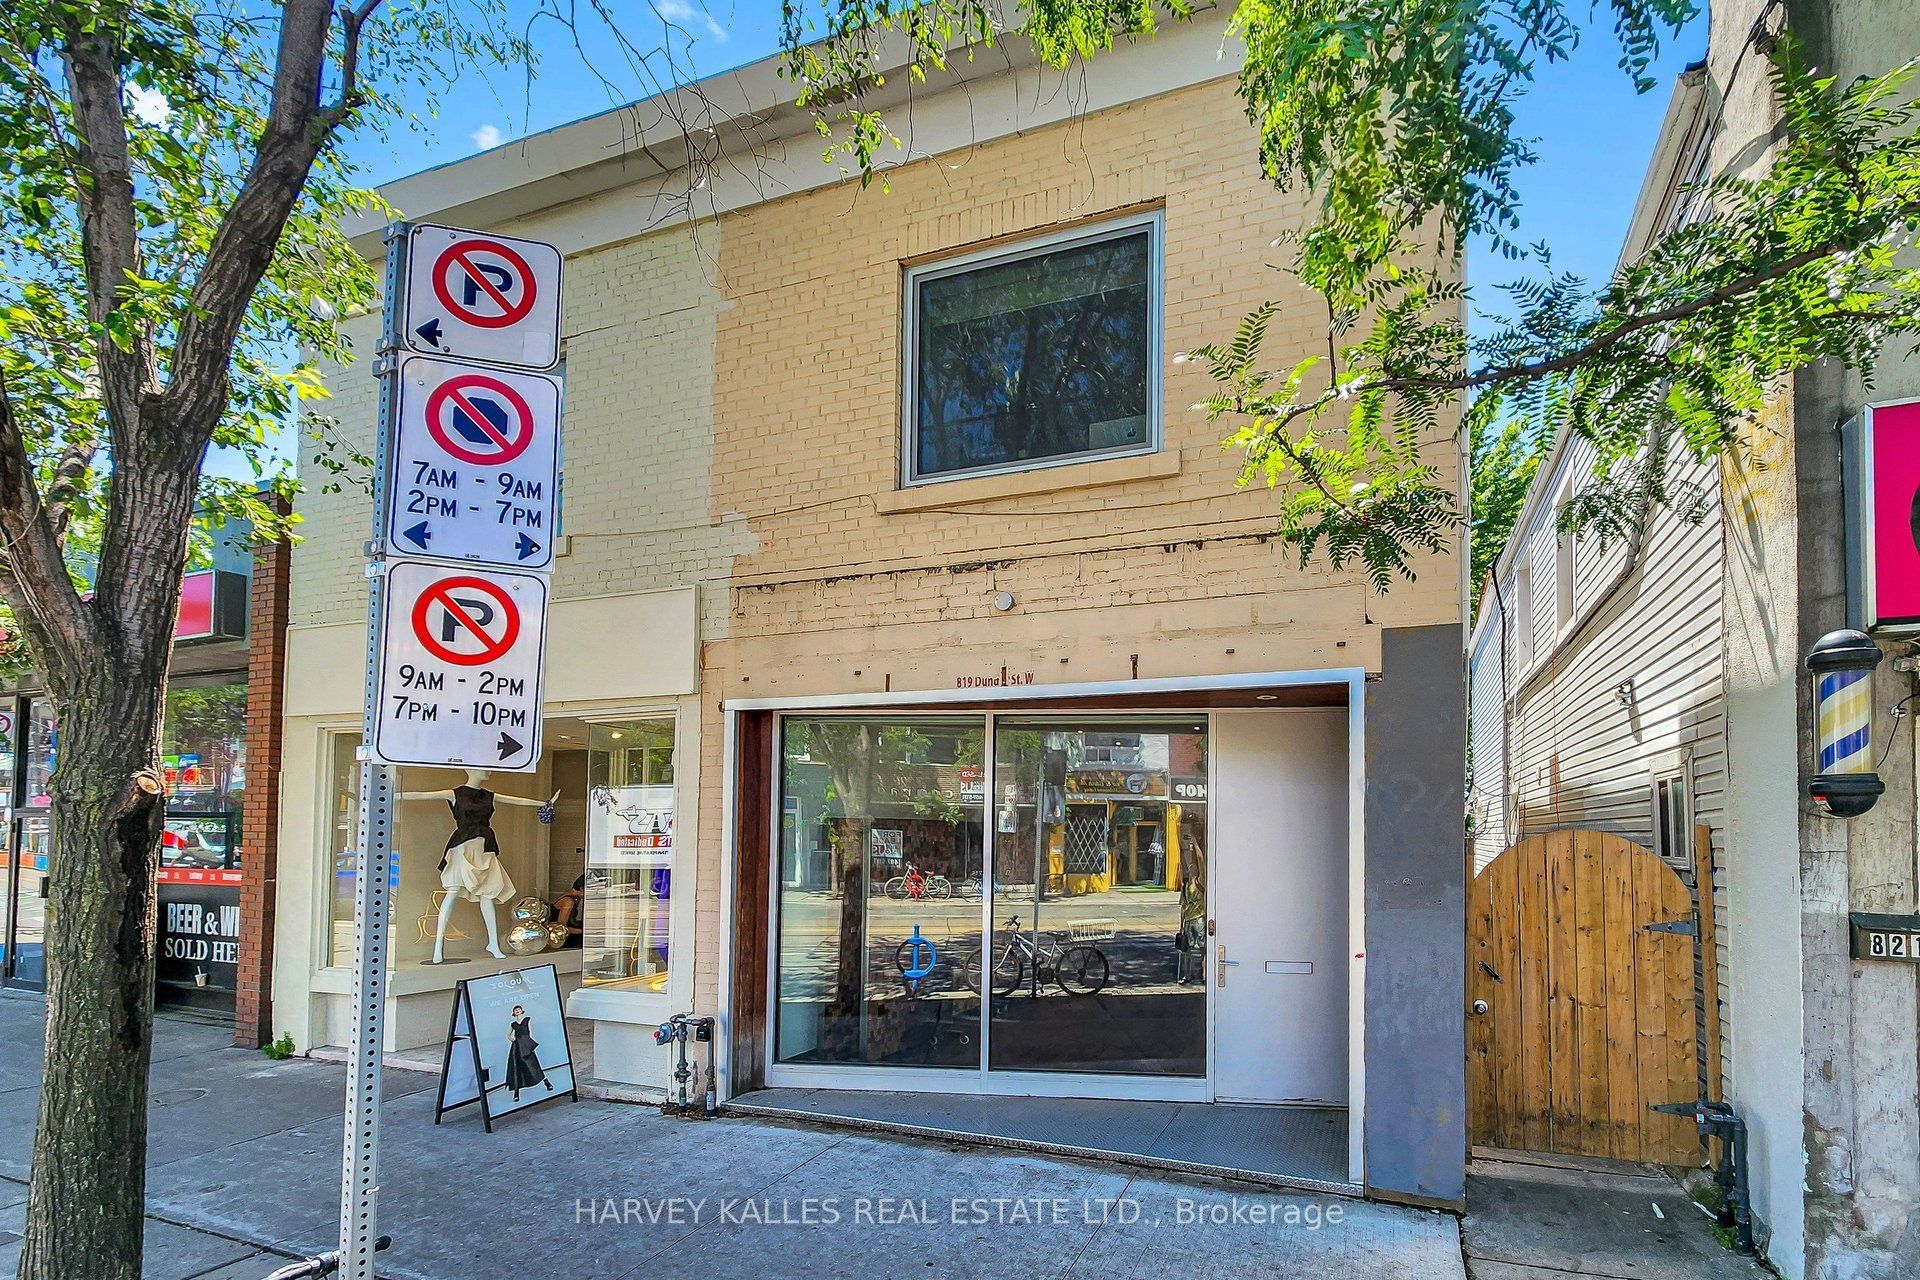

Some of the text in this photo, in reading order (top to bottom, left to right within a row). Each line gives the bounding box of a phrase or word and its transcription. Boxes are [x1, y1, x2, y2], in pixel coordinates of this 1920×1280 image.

[412, 460, 457, 489] 7AM
[497, 472, 542, 500] 9AM
[407, 489, 457, 518] 2PM
[495, 500, 542, 528] 7PM
[399, 664, 443, 691] 9AM
[478, 671, 524, 696] 2PM
[956, 676, 973, 688] 819
[1024, 672, 1034, 684] W
[393, 696, 438, 722] 7PM
[472, 701, 525, 727] 10PM
[167, 902, 203, 934] BEER
[204, 912, 219, 935] &
[165, 937, 240, 963] SOLD HE
